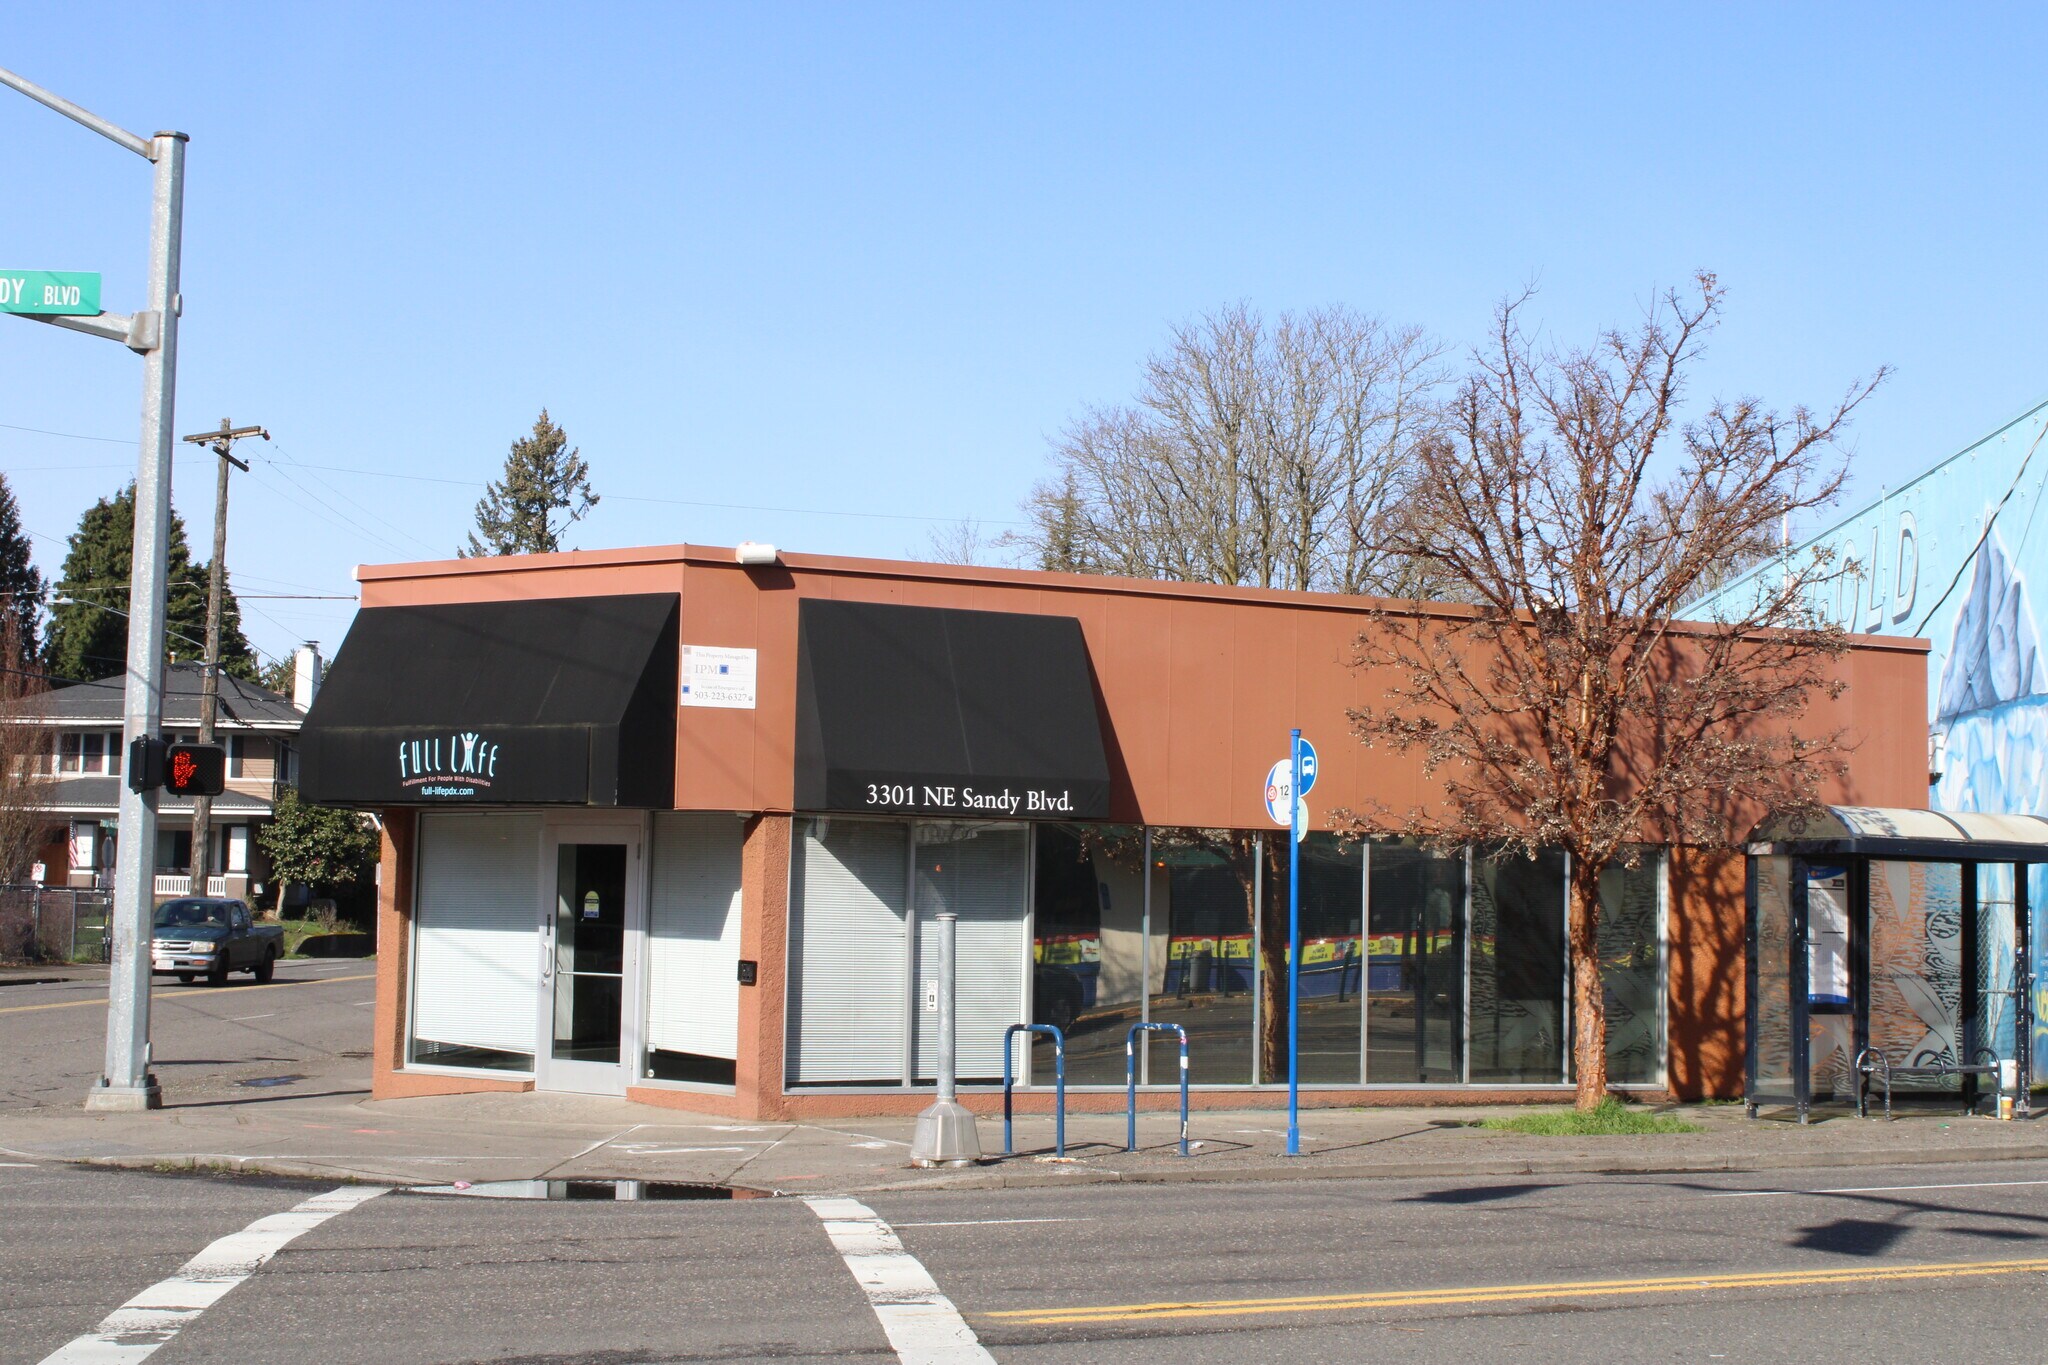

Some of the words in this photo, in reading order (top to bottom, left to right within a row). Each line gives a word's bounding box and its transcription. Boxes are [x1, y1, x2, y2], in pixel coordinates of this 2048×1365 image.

[44, 286, 81, 306] BLVD
[695, 664, 718, 675] IPM
[466, 776, 491, 787] Disabilities
[421, 786, 474, 797] full-lifepdx.com
[1280, 784, 1289, 796] 12
[866, 784, 915, 806] 3301
[923, 786, 956, 807] NE
[962, 787, 1020, 815] Sandy
[1026, 790, 1074, 811] Blvd.
